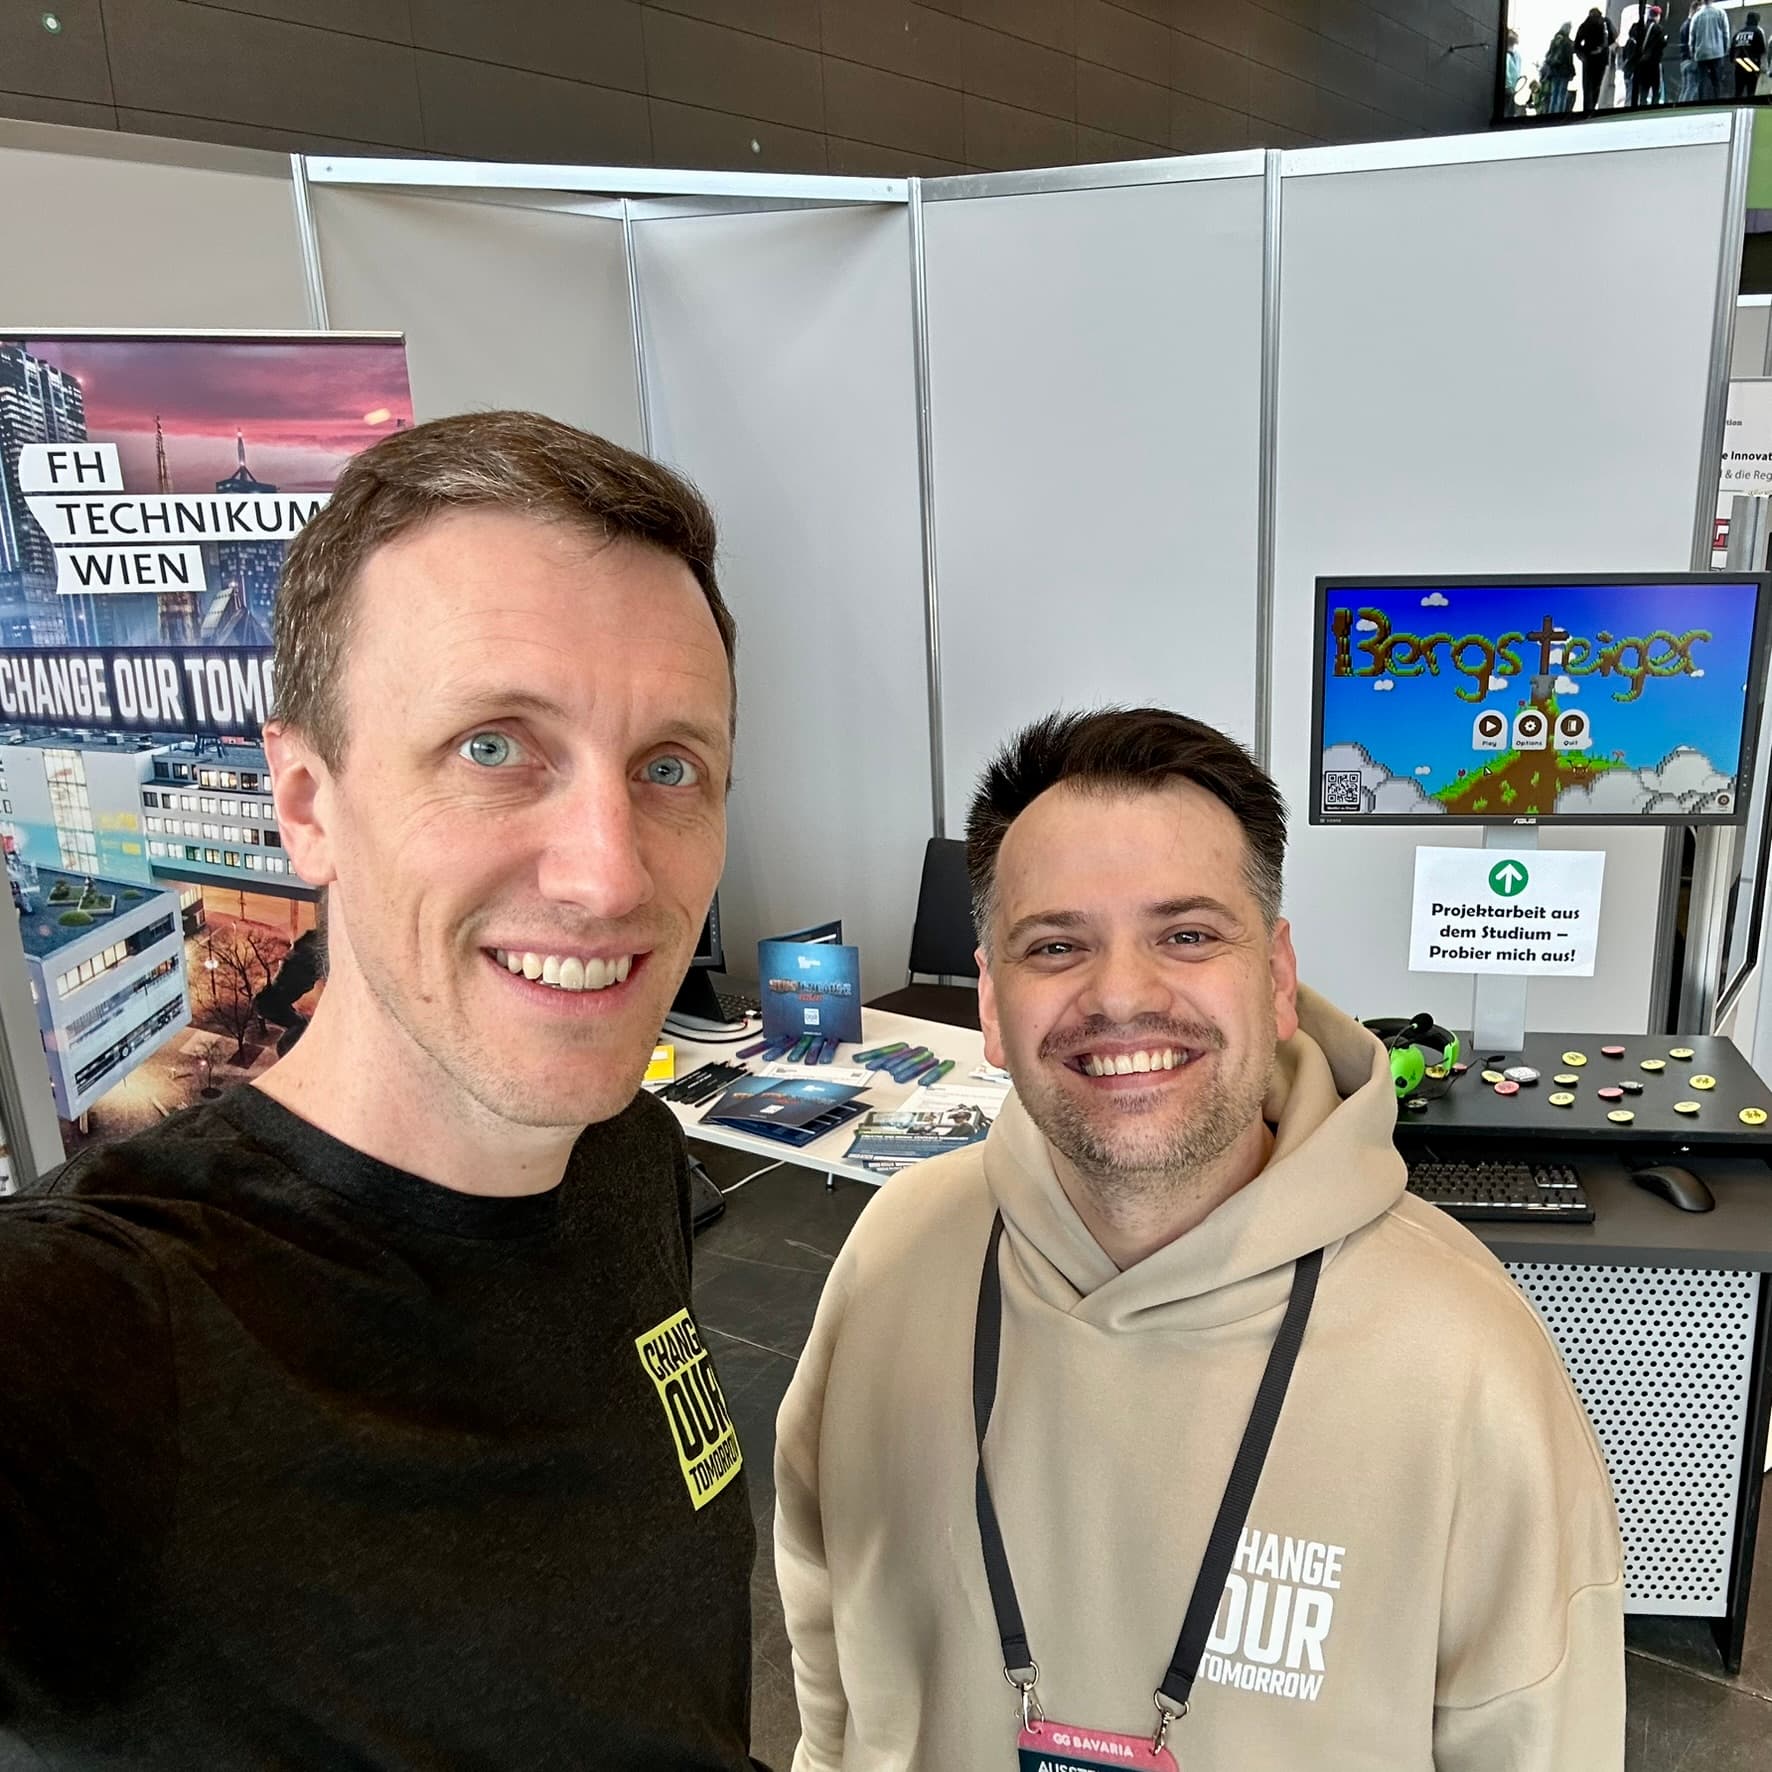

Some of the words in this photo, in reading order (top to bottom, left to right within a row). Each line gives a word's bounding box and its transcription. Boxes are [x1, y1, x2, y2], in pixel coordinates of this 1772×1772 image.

[47, 450, 106, 483] FH
[1725, 469, 1733, 479] &
[1734, 469, 1751, 480] die
[56, 500, 321, 535] TECHNIKUM
[70, 552, 190, 585] WIEN
[1331, 607, 1712, 703] Bergsteiger
[0, 657, 112, 717] CHANGE
[113, 657, 184, 721] OUR
[1431, 903, 1546, 919] Projektarbeit
[1551, 907, 1580, 920] aus
[1439, 925, 1476, 938] dem
[1481, 926, 1551, 940] Studium
[1429, 945, 1491, 960] Probier
[1496, 948, 1536, 961] mich
[1541, 949, 1576, 962] aus!
[643, 1317, 700, 1381] CHANG
[664, 1355, 731, 1462] OUR
[689, 1433, 740, 1495] TOMORRO
[1233, 1526, 1346, 1589] HANGE
[1205, 1573, 1334, 1672] OUR
[1198, 1652, 1325, 1701] TOMORROW
[1073, 1736, 1134, 1758] BAVARIA
